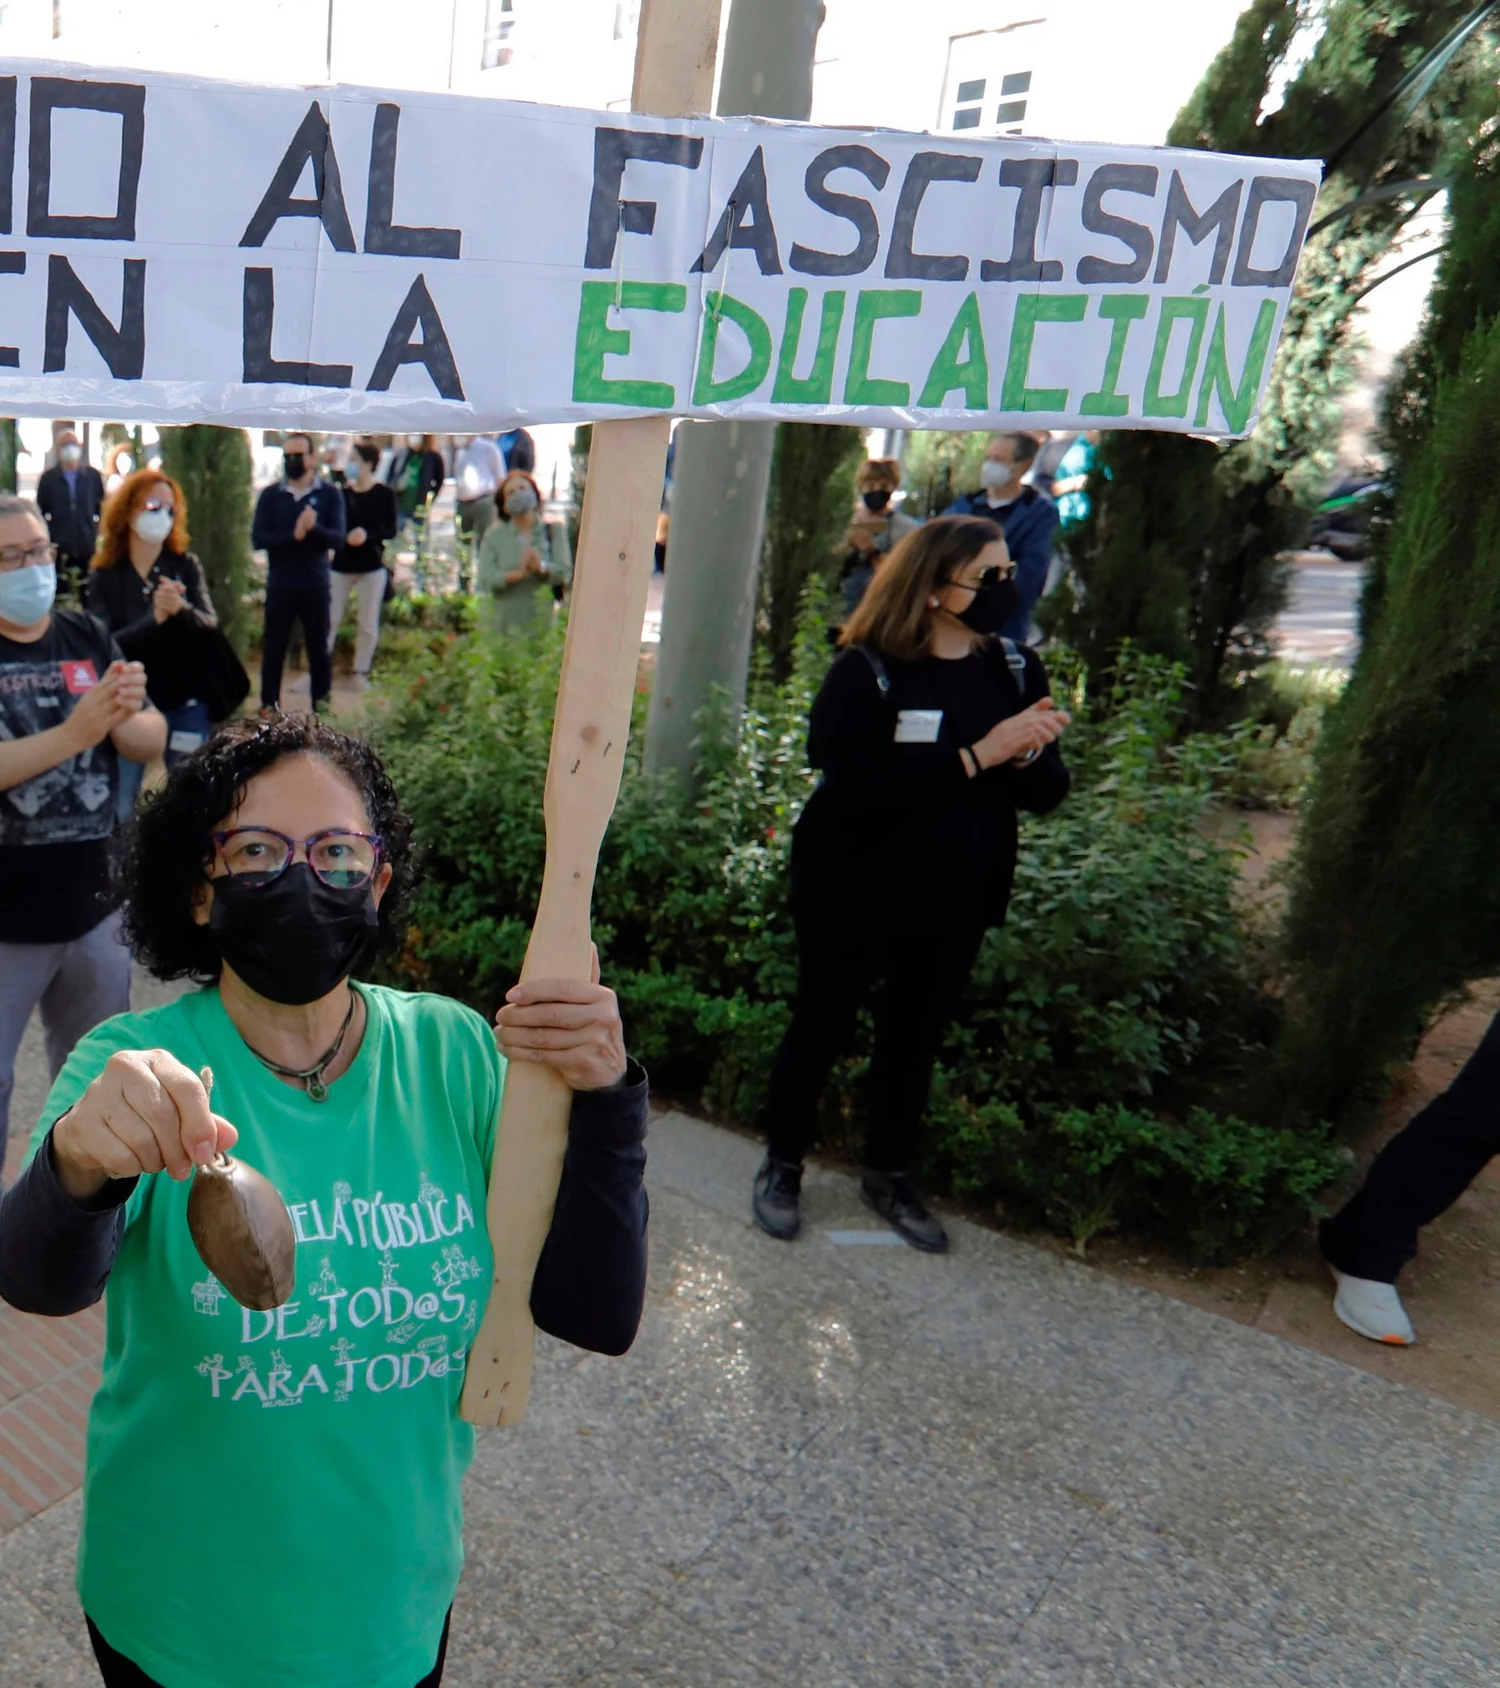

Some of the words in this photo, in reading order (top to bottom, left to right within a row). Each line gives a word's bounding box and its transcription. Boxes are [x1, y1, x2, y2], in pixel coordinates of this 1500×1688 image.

[239, 100, 462, 260] AL
[584, 126, 1318, 288] FASCISMO
[243, 266, 466, 402] LA
[572, 280, 1277, 434] EDUCACIÓN
[352, 1190, 475, 1251] PÚBLICA
[241, 1301, 308, 1344] DE
[317, 1279, 466, 1333] TOD@S
[210, 1364, 329, 1402] PARA
[334, 1344, 468, 1393] TOD@S
